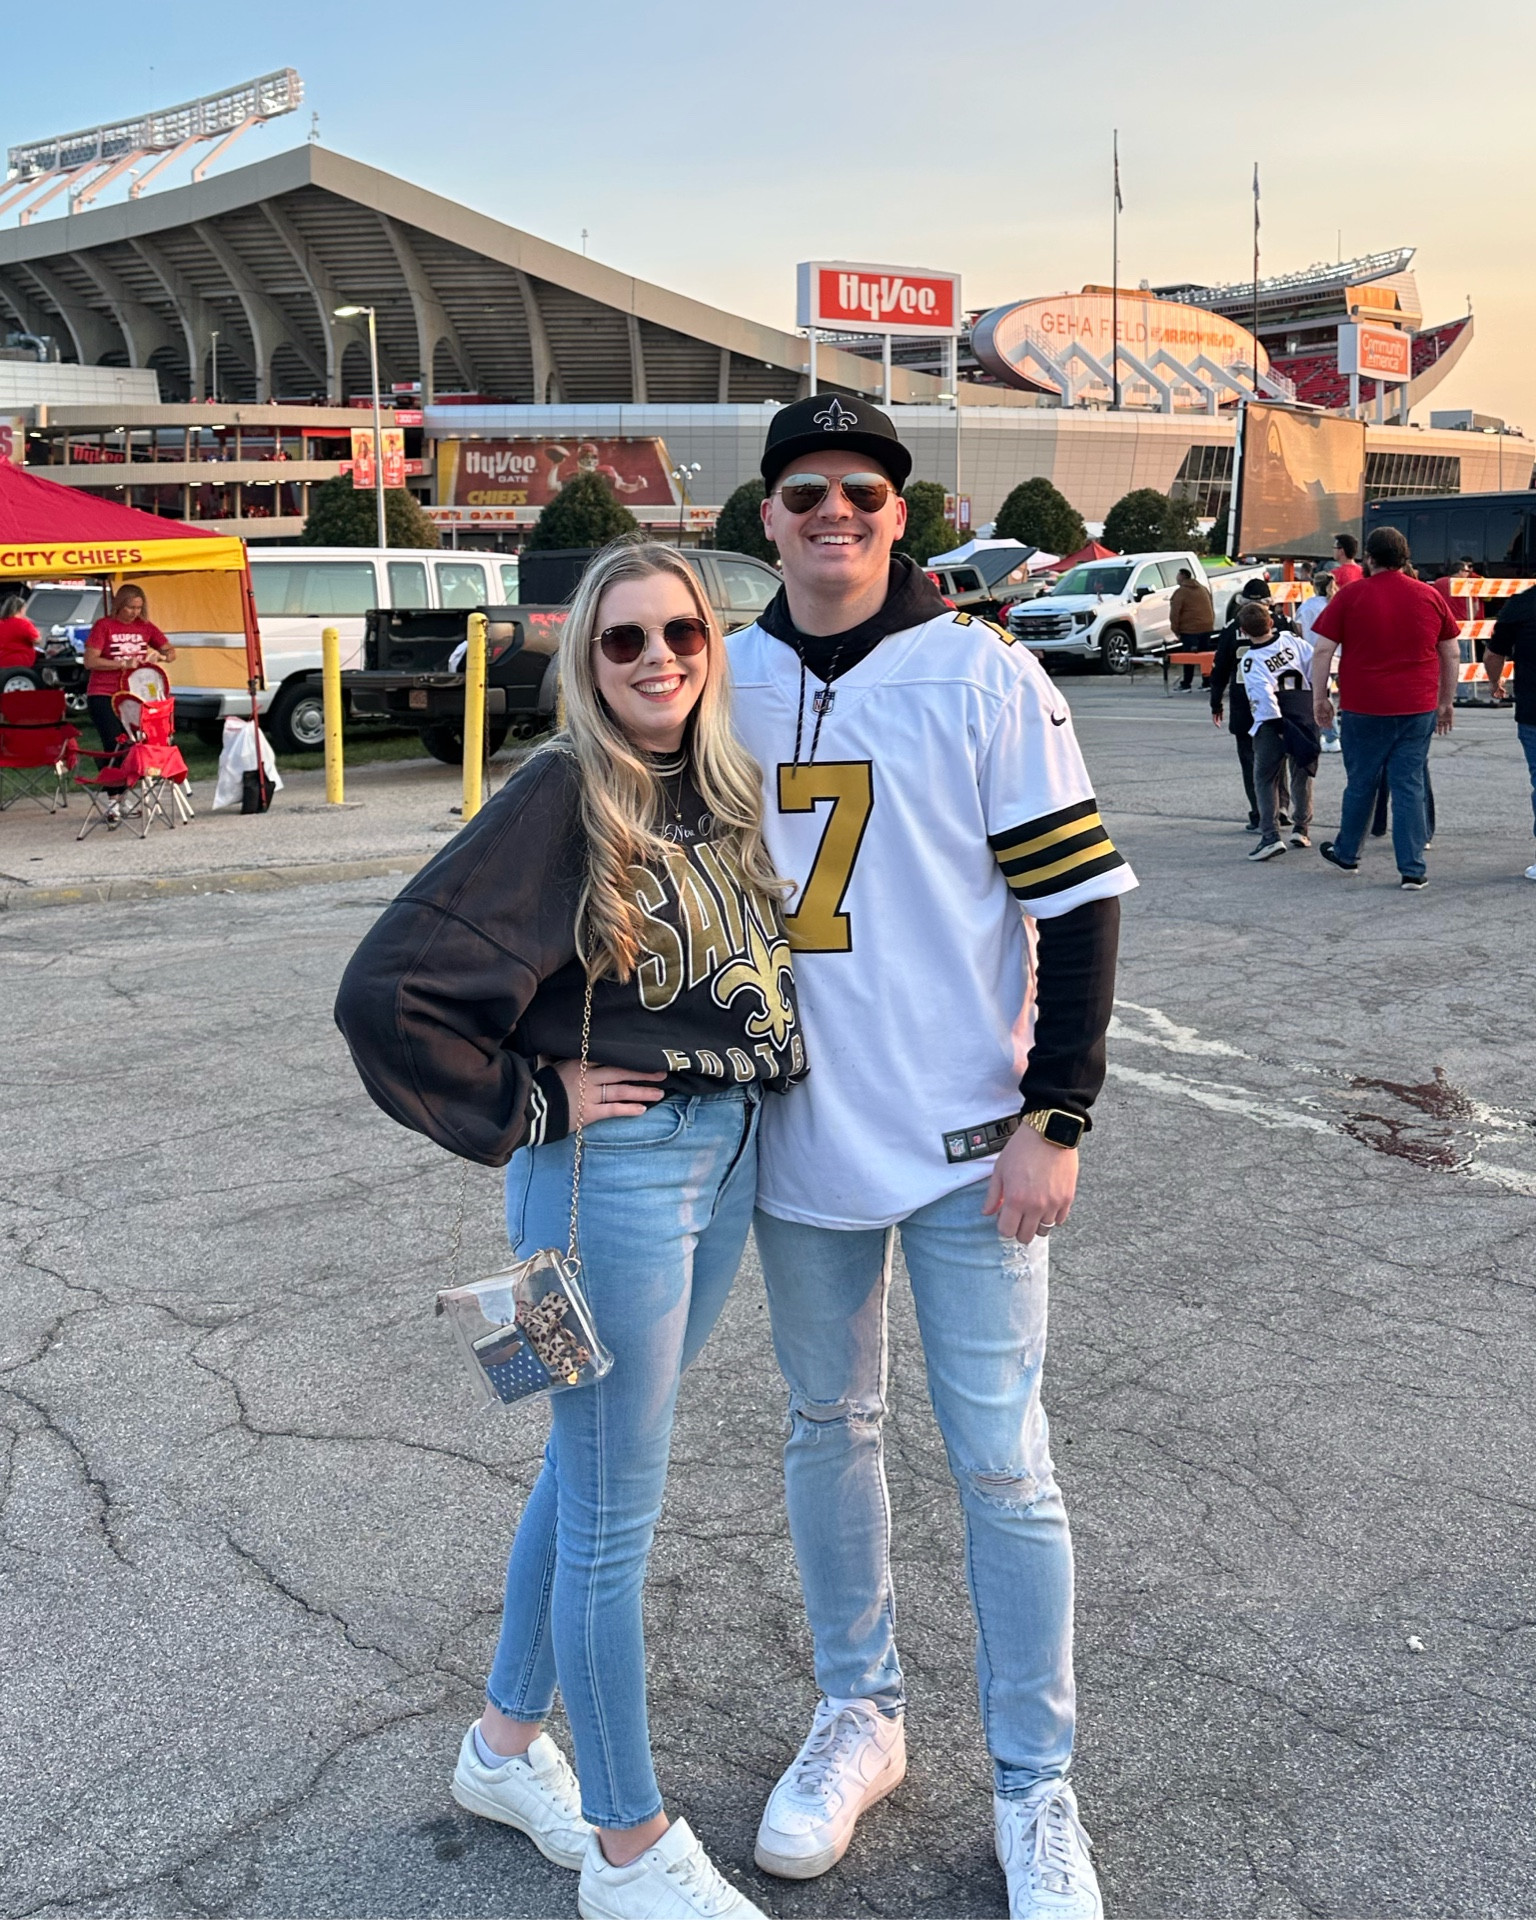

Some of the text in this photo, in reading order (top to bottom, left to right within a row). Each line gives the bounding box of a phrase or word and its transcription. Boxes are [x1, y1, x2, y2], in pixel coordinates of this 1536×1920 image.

[1040, 311, 1094, 339] GEHA
[1361, 333, 1405, 361] Community
[497, 474, 529, 484] GATE
[466, 489, 529, 505] CHIEFS
[469, 510, 516, 520] GATE
[0, 548, 143, 568] CITY CHIEFS
[1243, 658, 1253, 674] 9
[776, 760, 875, 954] 7
